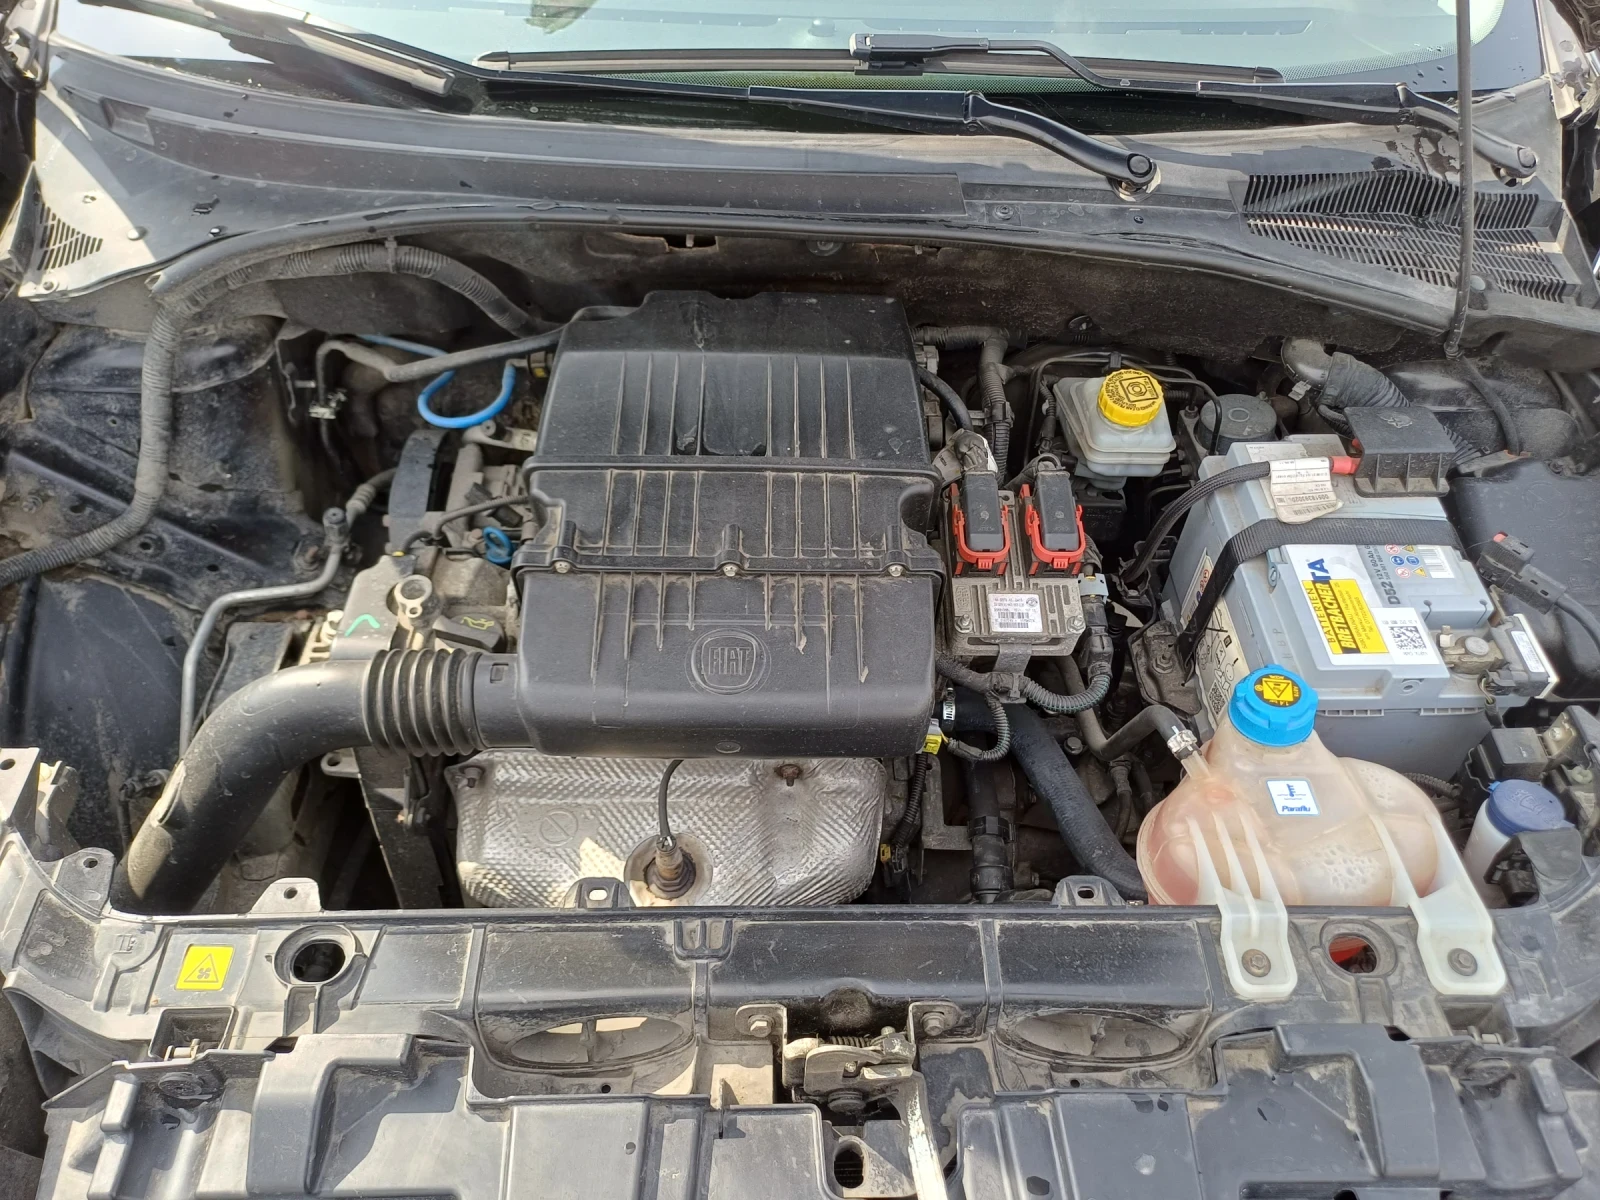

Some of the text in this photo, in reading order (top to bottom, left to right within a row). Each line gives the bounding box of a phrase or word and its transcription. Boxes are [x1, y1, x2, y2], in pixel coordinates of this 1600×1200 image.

[1375, 568, 1384, 580] 12V
[1380, 580, 1401, 605] D52
[1307, 587, 1336, 643] BATTERIEN
[708, 646, 751, 676] FIAT
